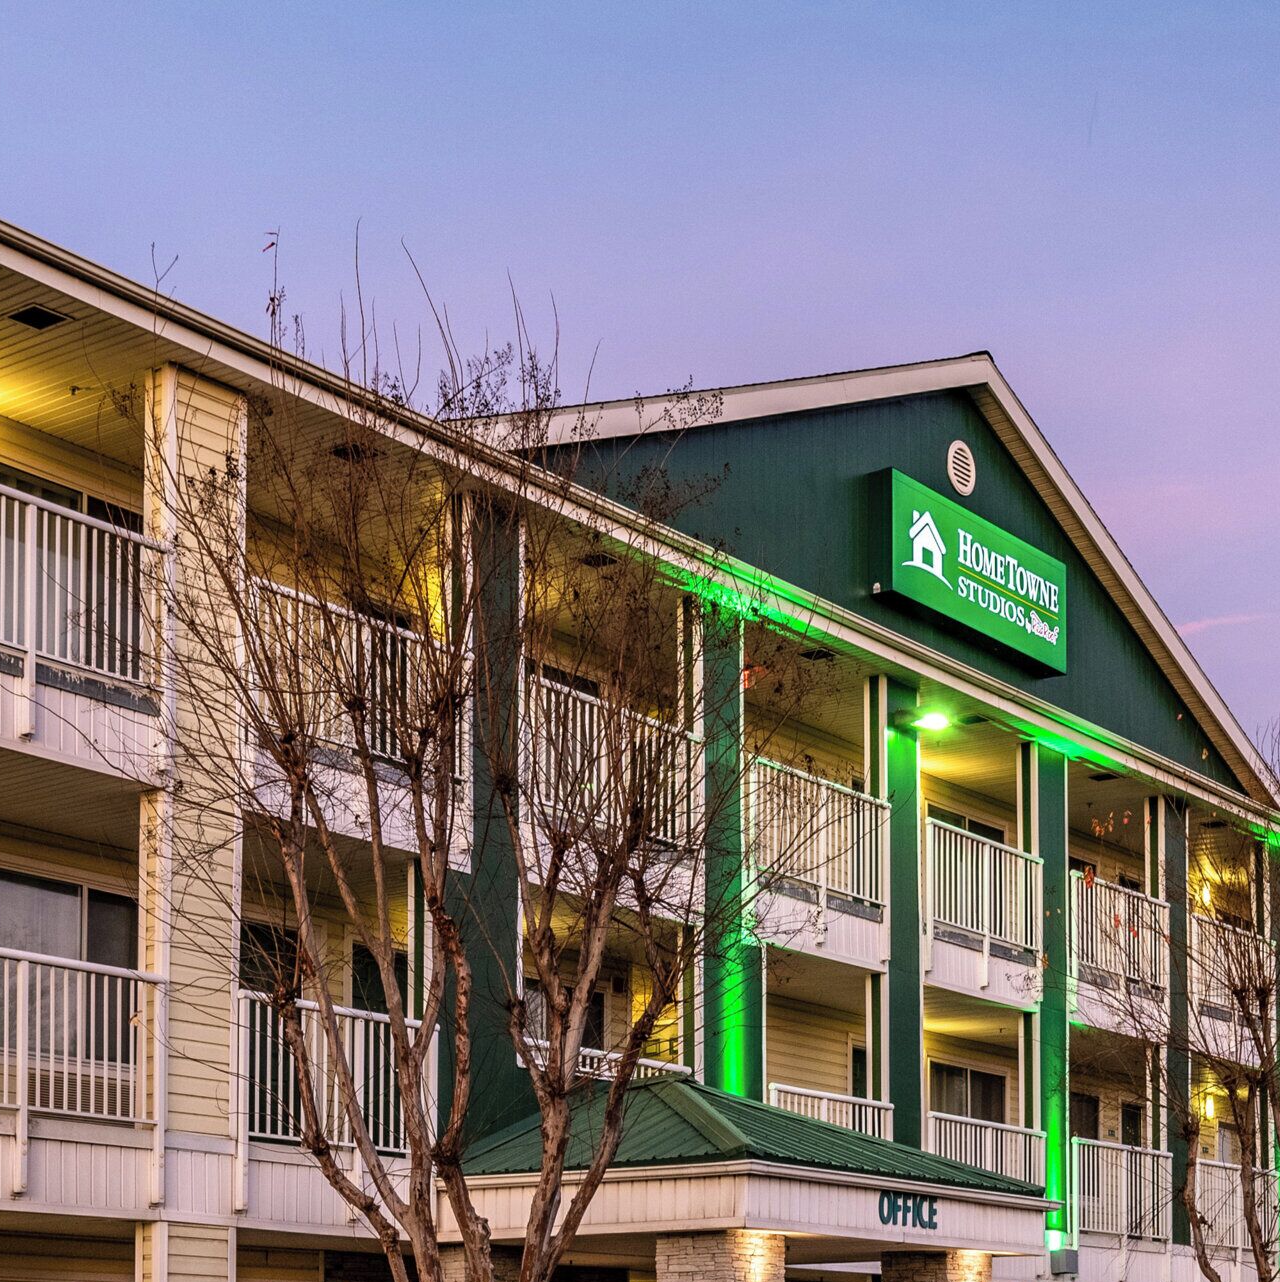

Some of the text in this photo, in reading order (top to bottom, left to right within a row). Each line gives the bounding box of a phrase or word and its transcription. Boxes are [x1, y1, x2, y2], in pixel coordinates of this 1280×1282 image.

[958, 528, 1059, 613] HOMETOWNE
[958, 576, 1025, 627] STUDIOS
[879, 1190, 938, 1230] OFFICE
